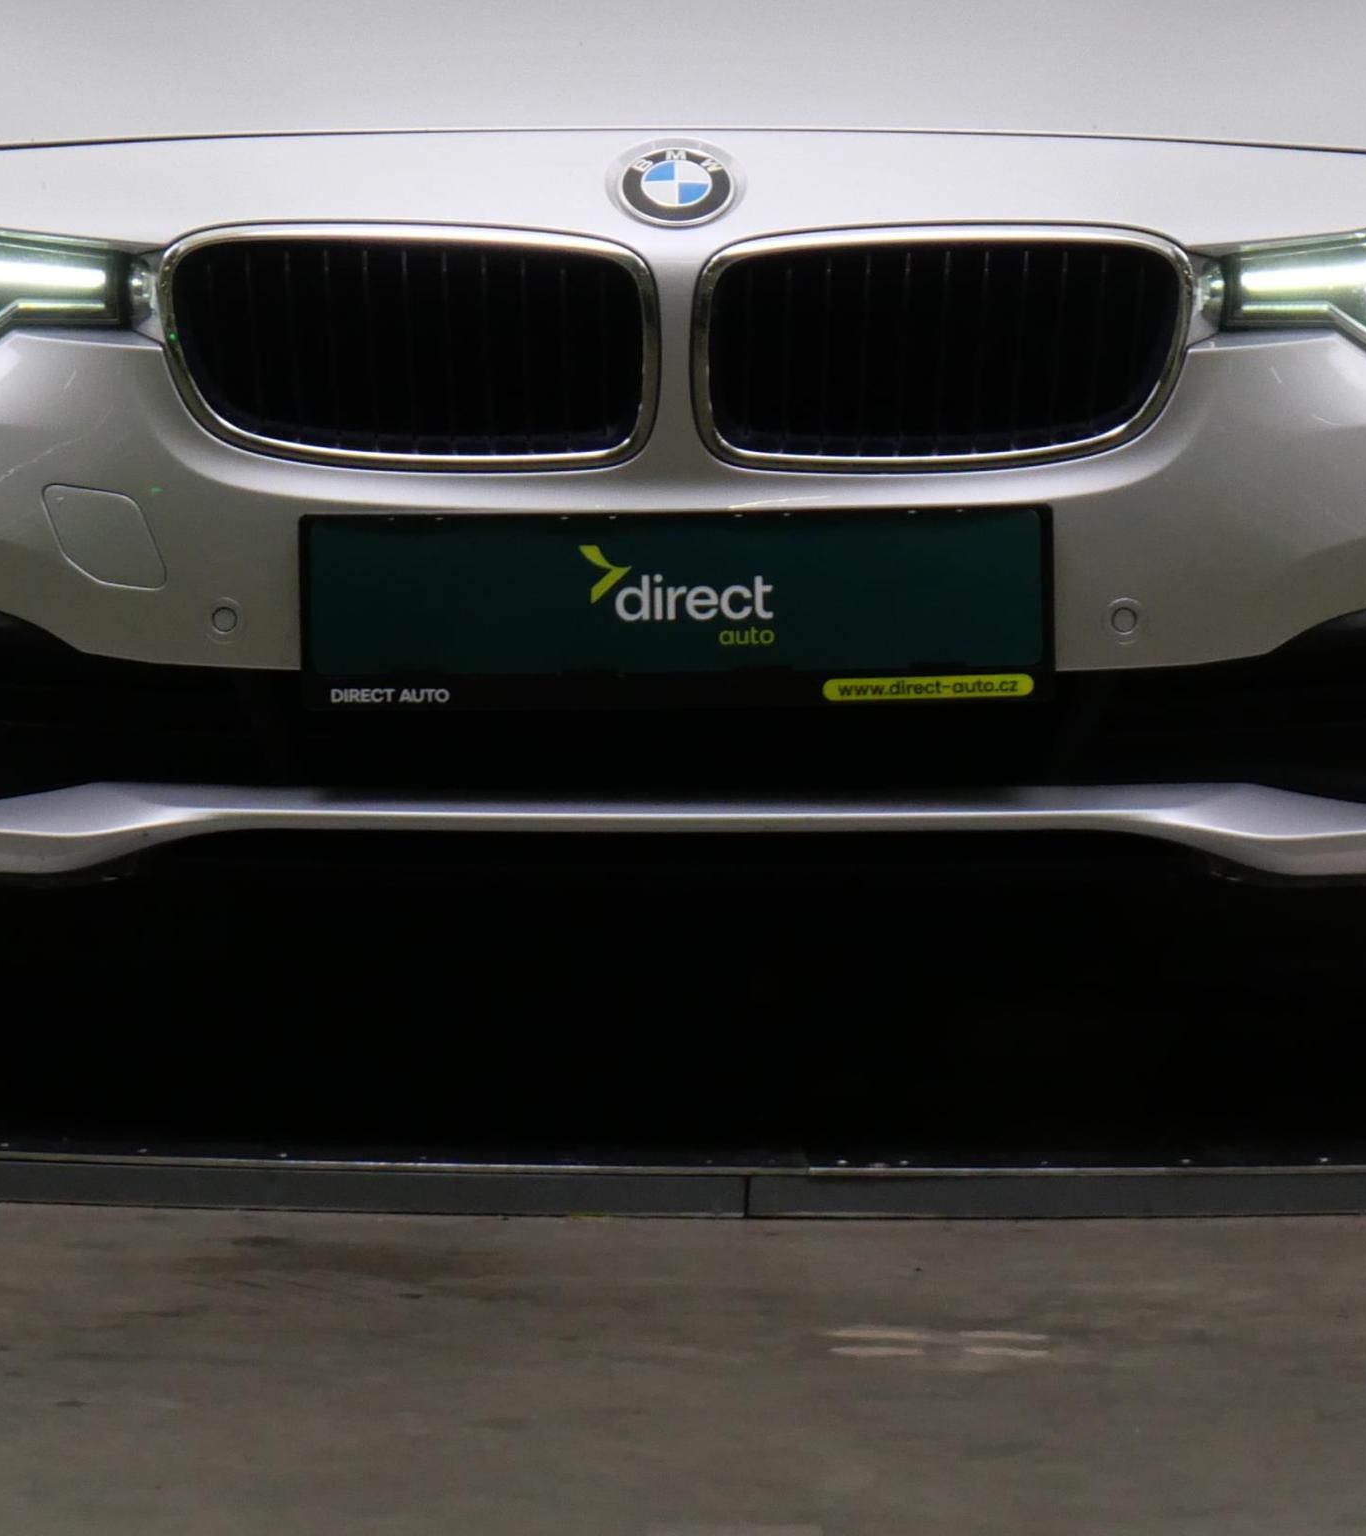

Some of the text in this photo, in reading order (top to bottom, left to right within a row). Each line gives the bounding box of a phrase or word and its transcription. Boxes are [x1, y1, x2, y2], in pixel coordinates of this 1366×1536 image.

[632, 149, 724, 172] BMW
[615, 573, 774, 622] direct
[718, 626, 775, 645] auto
[330, 688, 450, 703] DIRECT AUTO
[837, 679, 1019, 696] www.direct-auto.cz
